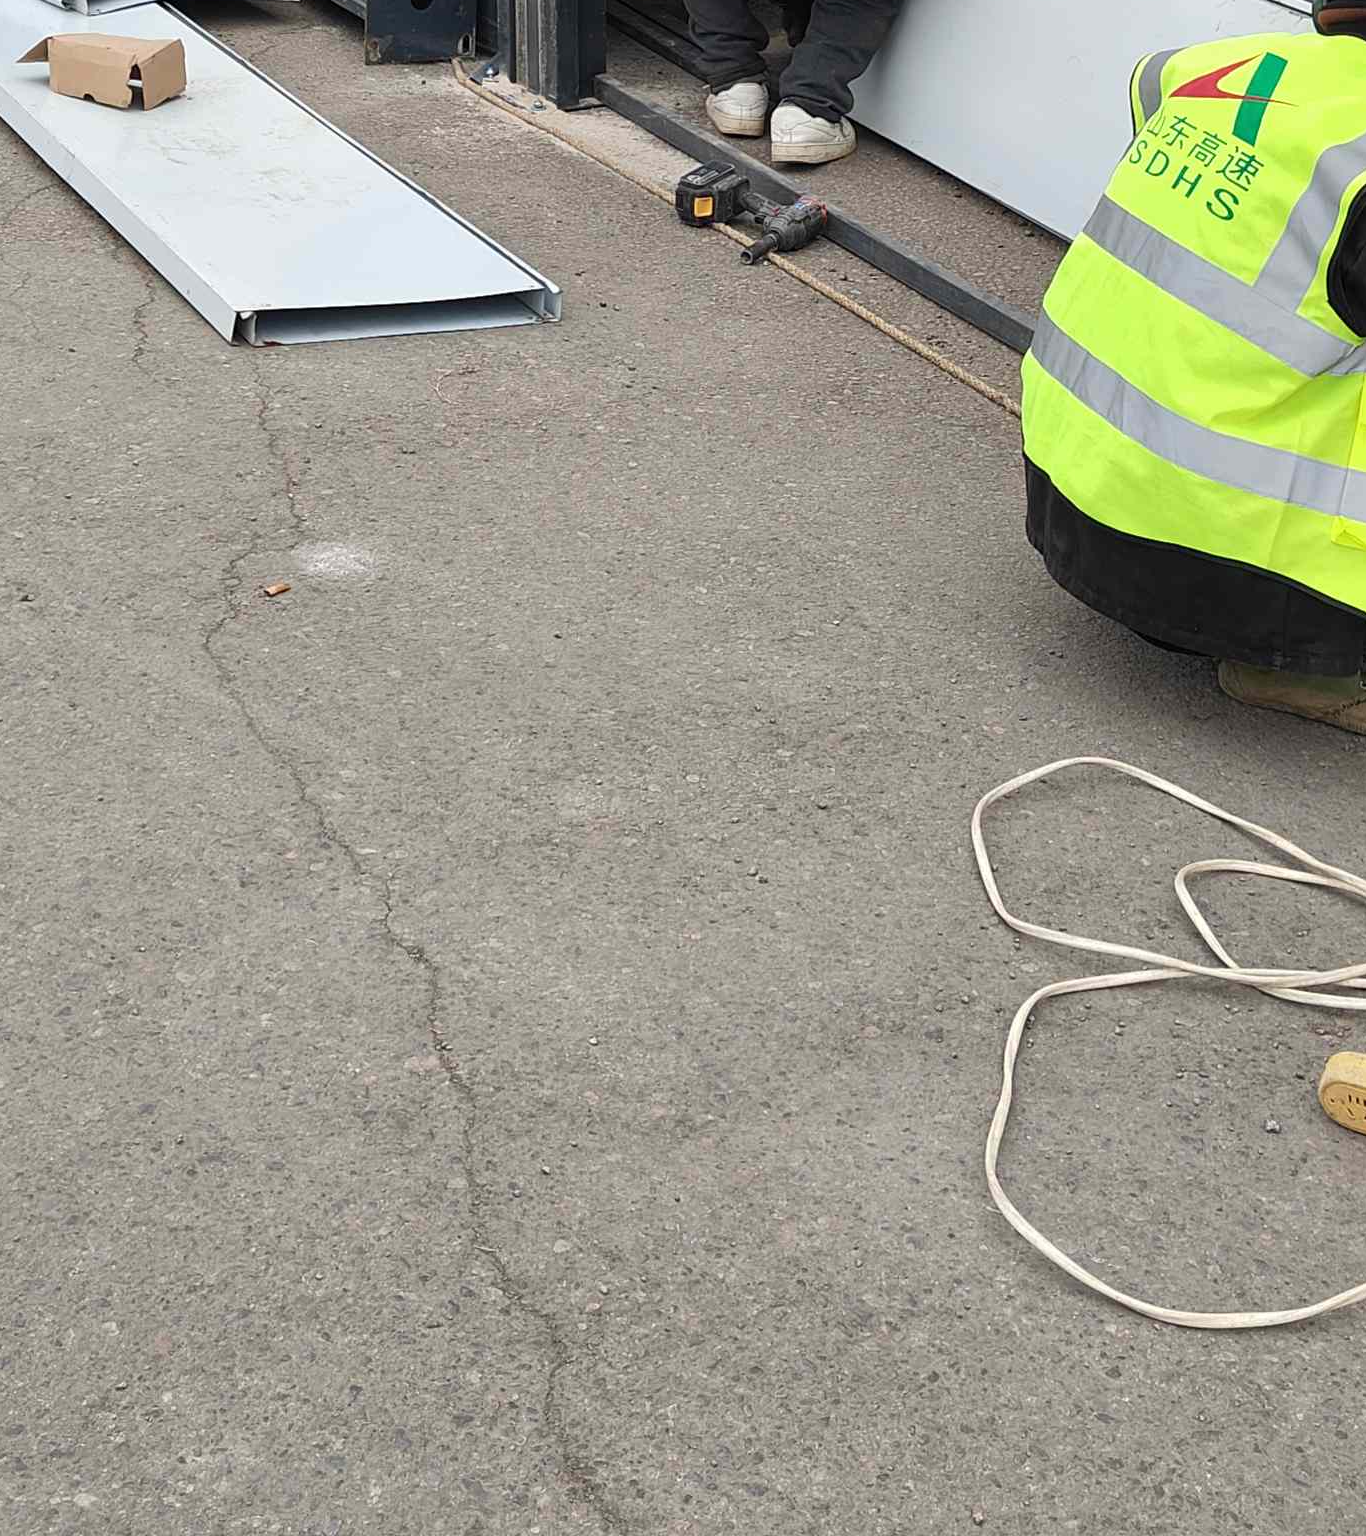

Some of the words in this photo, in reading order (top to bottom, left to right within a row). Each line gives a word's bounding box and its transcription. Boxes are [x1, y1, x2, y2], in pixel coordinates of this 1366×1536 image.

[1129, 139, 1240, 221] SDHS
[1146, 113, 1265, 192] 山东高速
